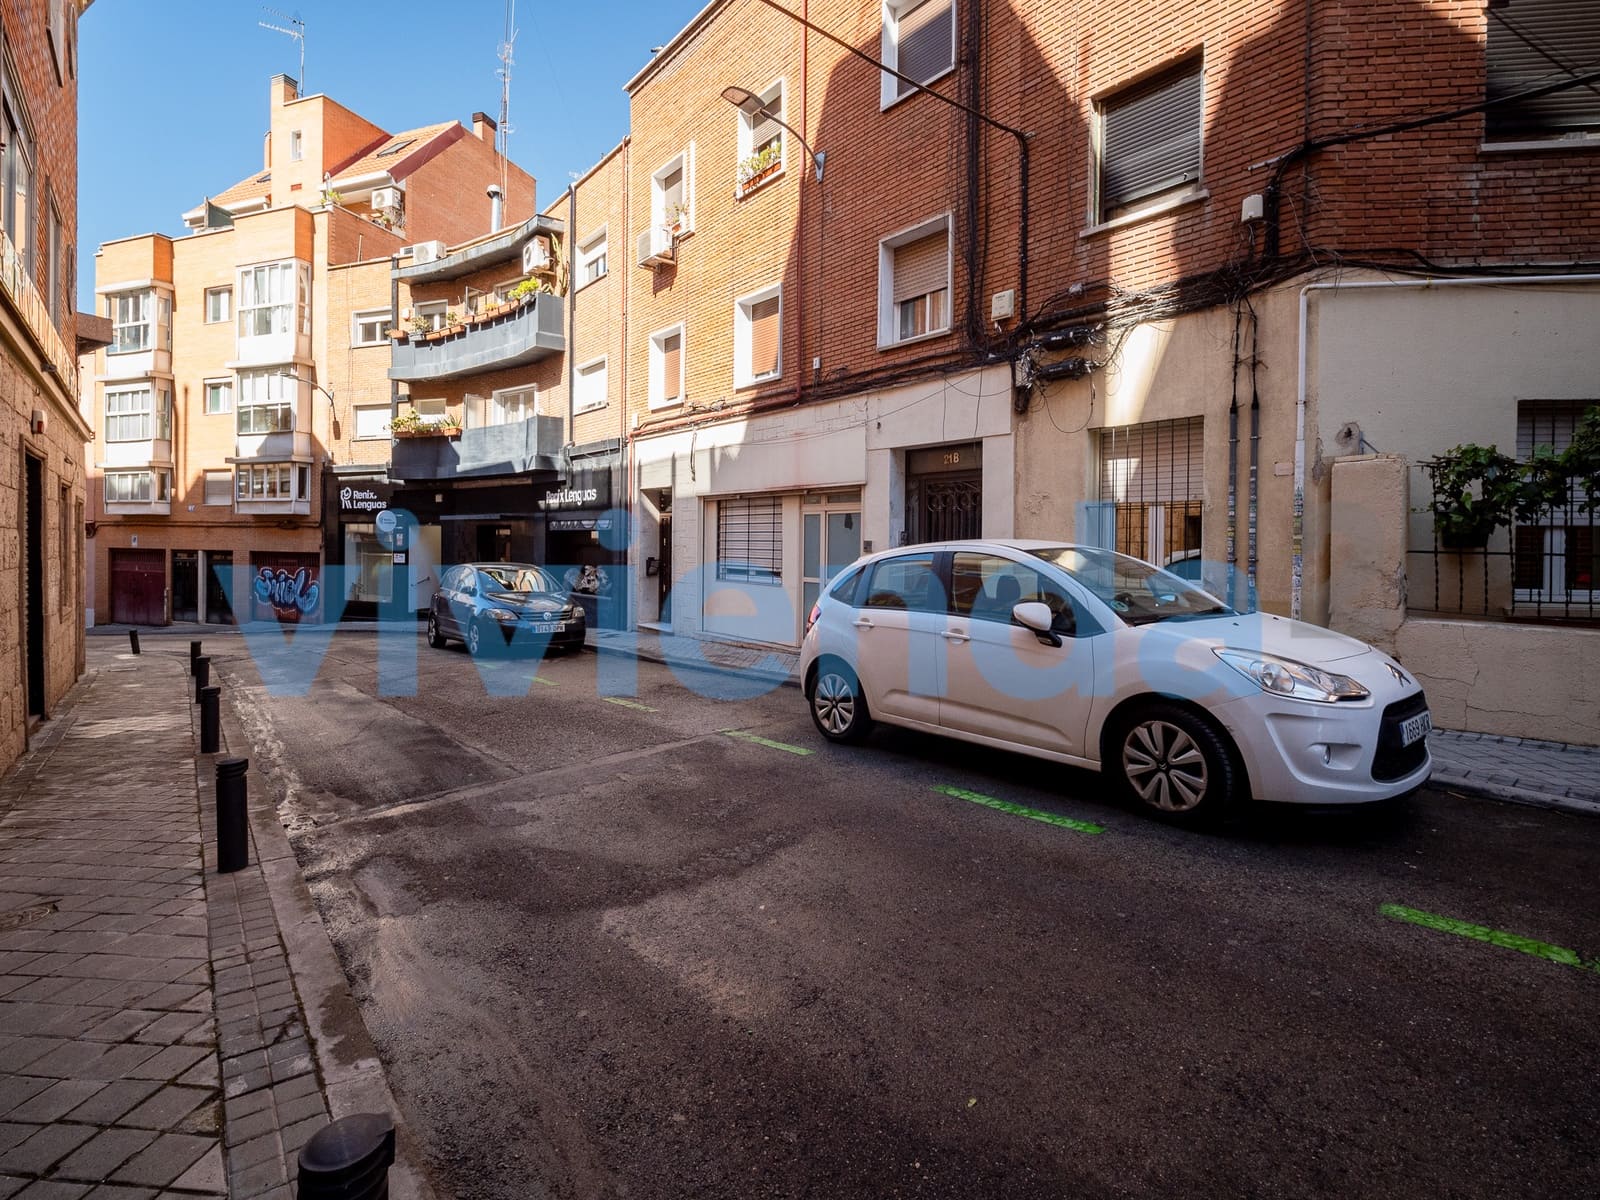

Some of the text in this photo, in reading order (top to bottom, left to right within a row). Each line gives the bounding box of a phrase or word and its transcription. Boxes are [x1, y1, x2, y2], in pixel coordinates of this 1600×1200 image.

[943, 452, 960, 465] 21B
[565, 488, 597, 506] Lenguas
[353, 500, 387, 511] Lenguas
[1405, 719, 1420, 741] 1669
